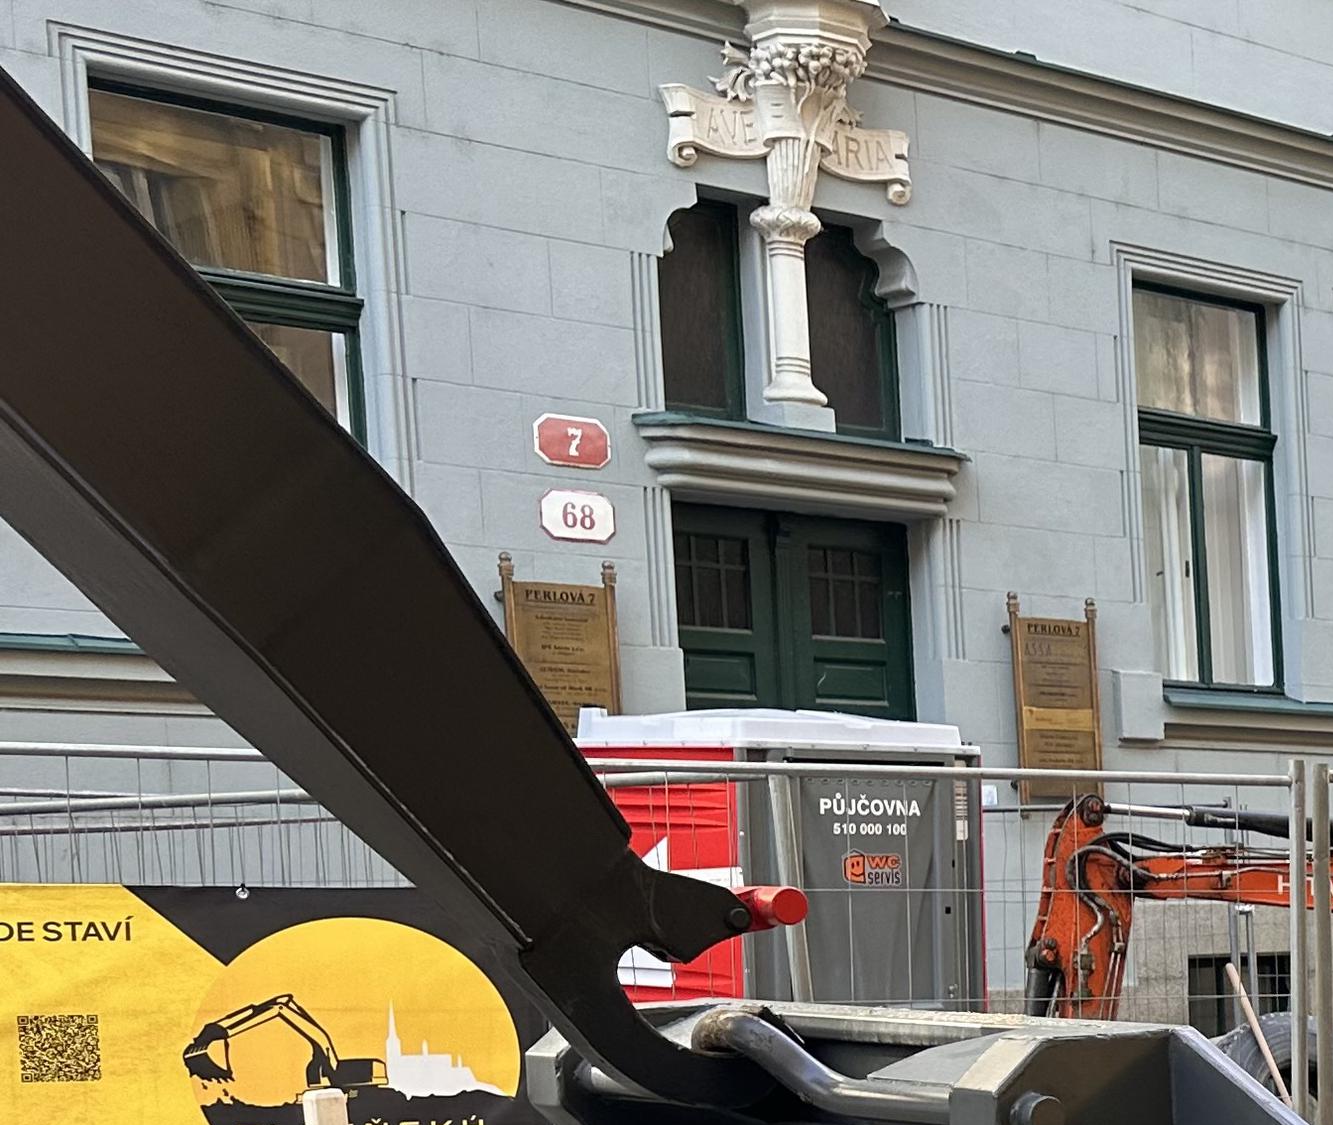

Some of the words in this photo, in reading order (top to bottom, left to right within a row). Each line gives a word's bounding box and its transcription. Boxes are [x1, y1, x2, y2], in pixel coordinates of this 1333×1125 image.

[707, 107, 757, 145] AVE
[567, 427, 582, 456] 7
[562, 502, 596, 530] 68
[525, 589, 585, 603] PERLOVÁ
[819, 792, 921, 816] PŮJČOVNA
[833, 823, 857, 834] 510
[860, 823, 882, 834] 000
[886, 824, 907, 835] 100
[867, 855, 901, 868] WC
[868, 870, 900, 884] servis
[43, 916, 134, 941] STAVÍ
